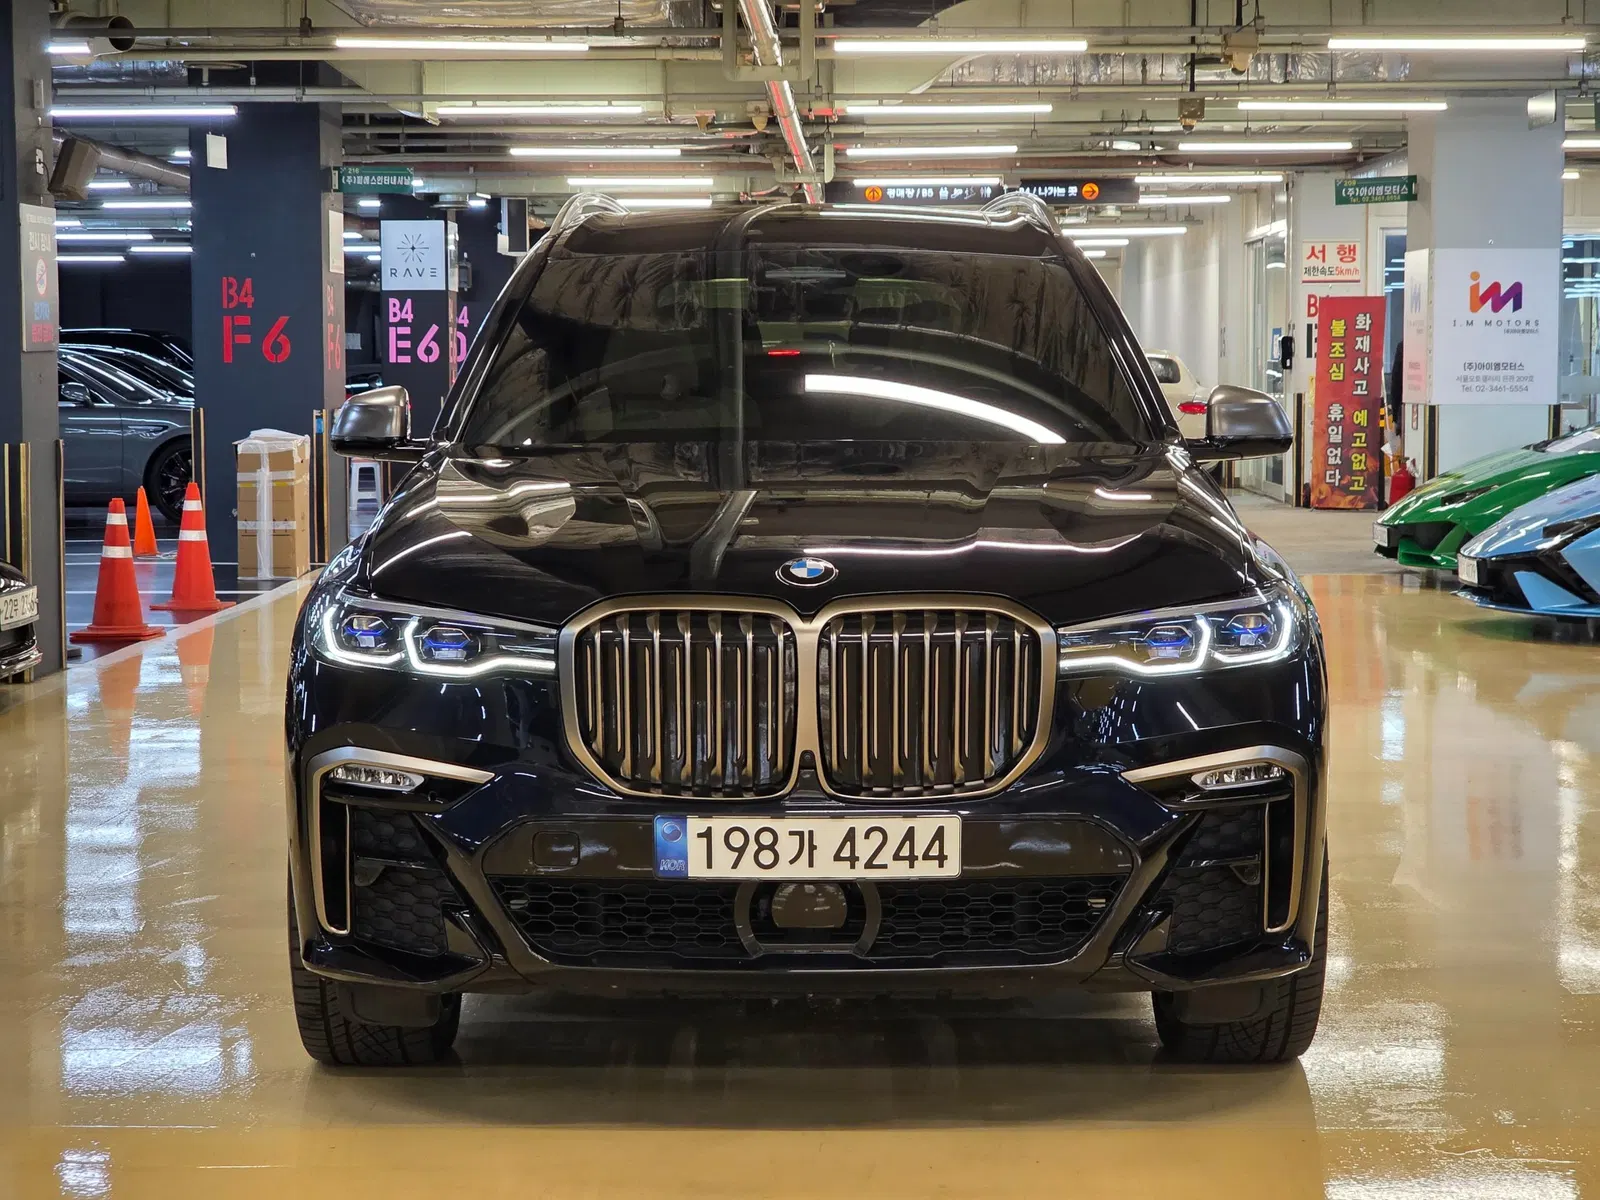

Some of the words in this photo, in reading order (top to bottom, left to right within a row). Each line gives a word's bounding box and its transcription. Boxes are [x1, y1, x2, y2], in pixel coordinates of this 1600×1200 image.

[389, 267, 438, 278] RAVE
[222, 276, 255, 309] B4
[388, 297, 414, 323] B4
[1484, 319, 1540, 328] MOTORS
[388, 323, 440, 363] E6
[1328, 319, 1347, 381] 불조심
[1352, 313, 1372, 395] 화재사고
[1475, 385, 1529, 393] 02-3461-5554
[1325, 403, 1345, 487] 휴일없다
[1349, 409, 1369, 491] 예고없고
[659, 858, 686, 871] KOR
[696, 825, 818, 870] 198가
[833, 825, 949, 870] 4244
